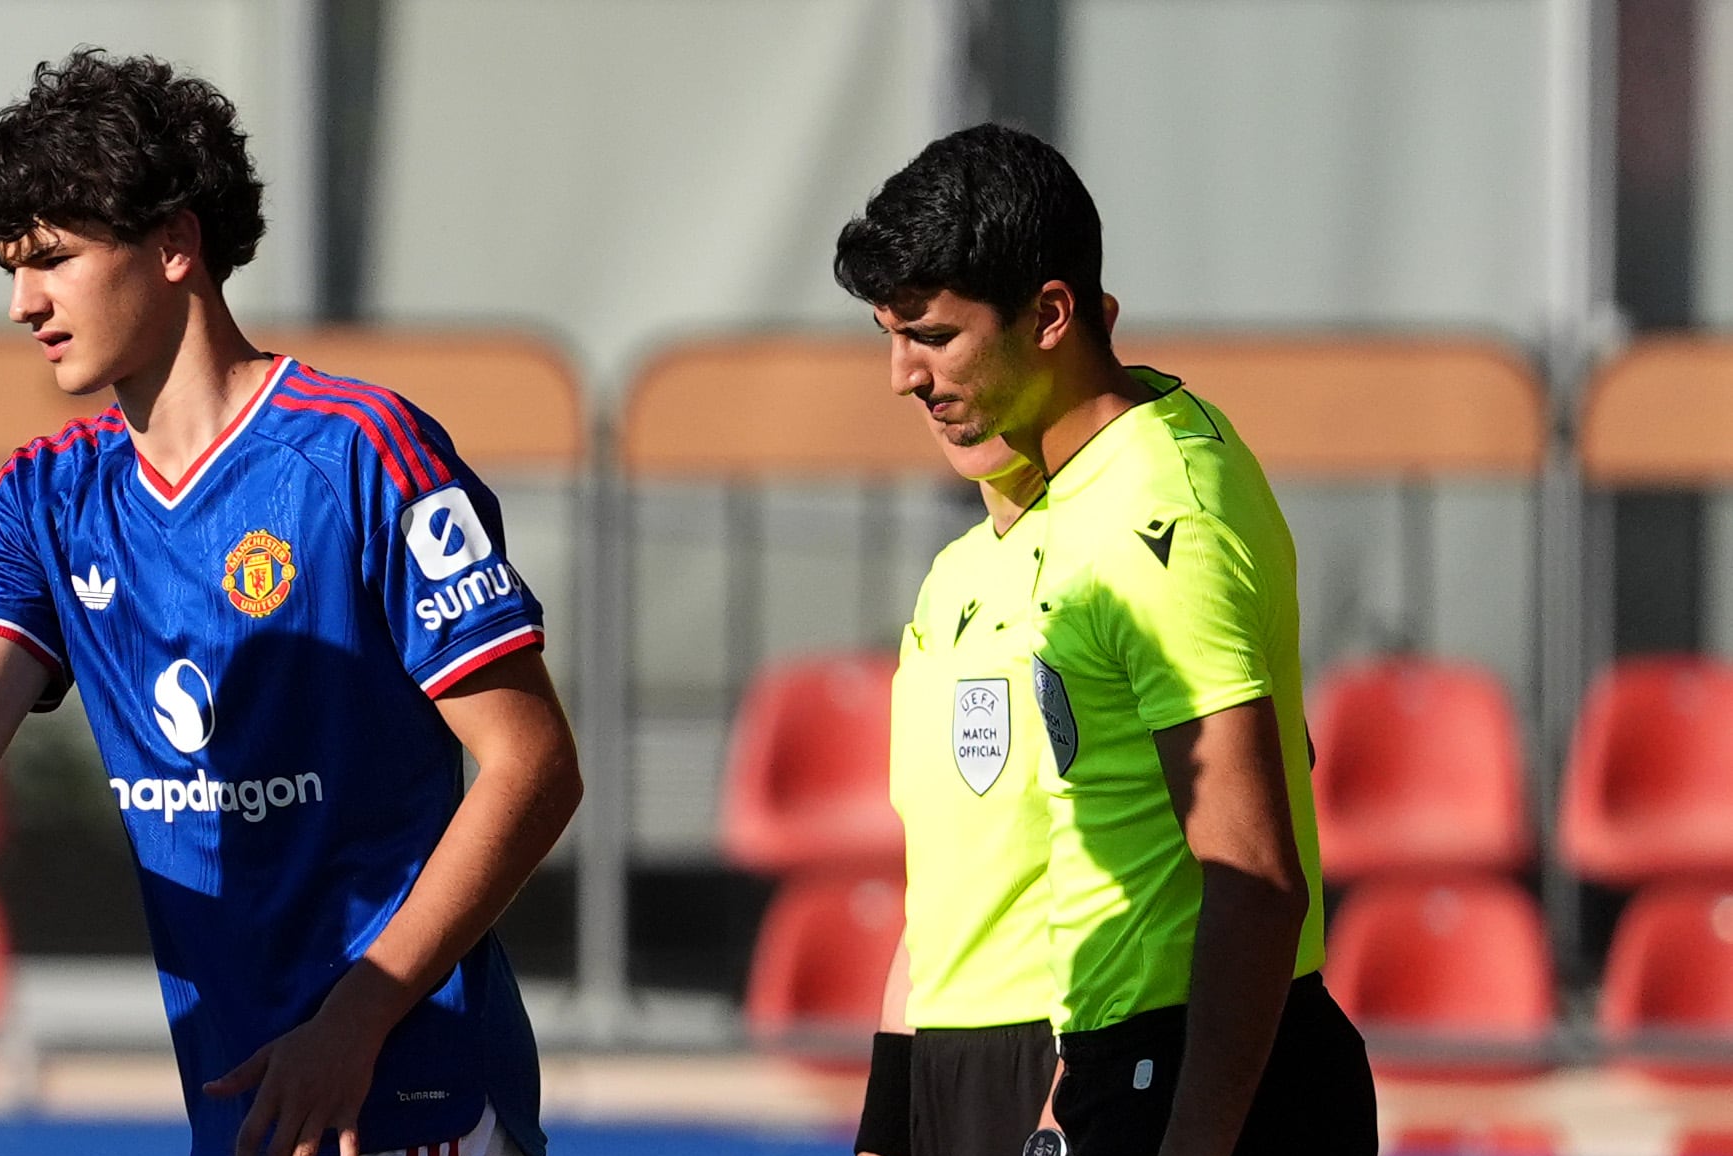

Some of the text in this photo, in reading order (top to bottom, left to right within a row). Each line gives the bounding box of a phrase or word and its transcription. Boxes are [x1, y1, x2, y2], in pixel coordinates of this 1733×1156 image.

[229, 536, 287, 568] MANCHESTER
[240, 593, 281, 611] UNITED
[961, 692, 996, 712] UEFA
[963, 728, 997, 741] MATCH
[959, 746, 1002, 758] OFFICIAL
[109, 769, 323, 823] napdragon
